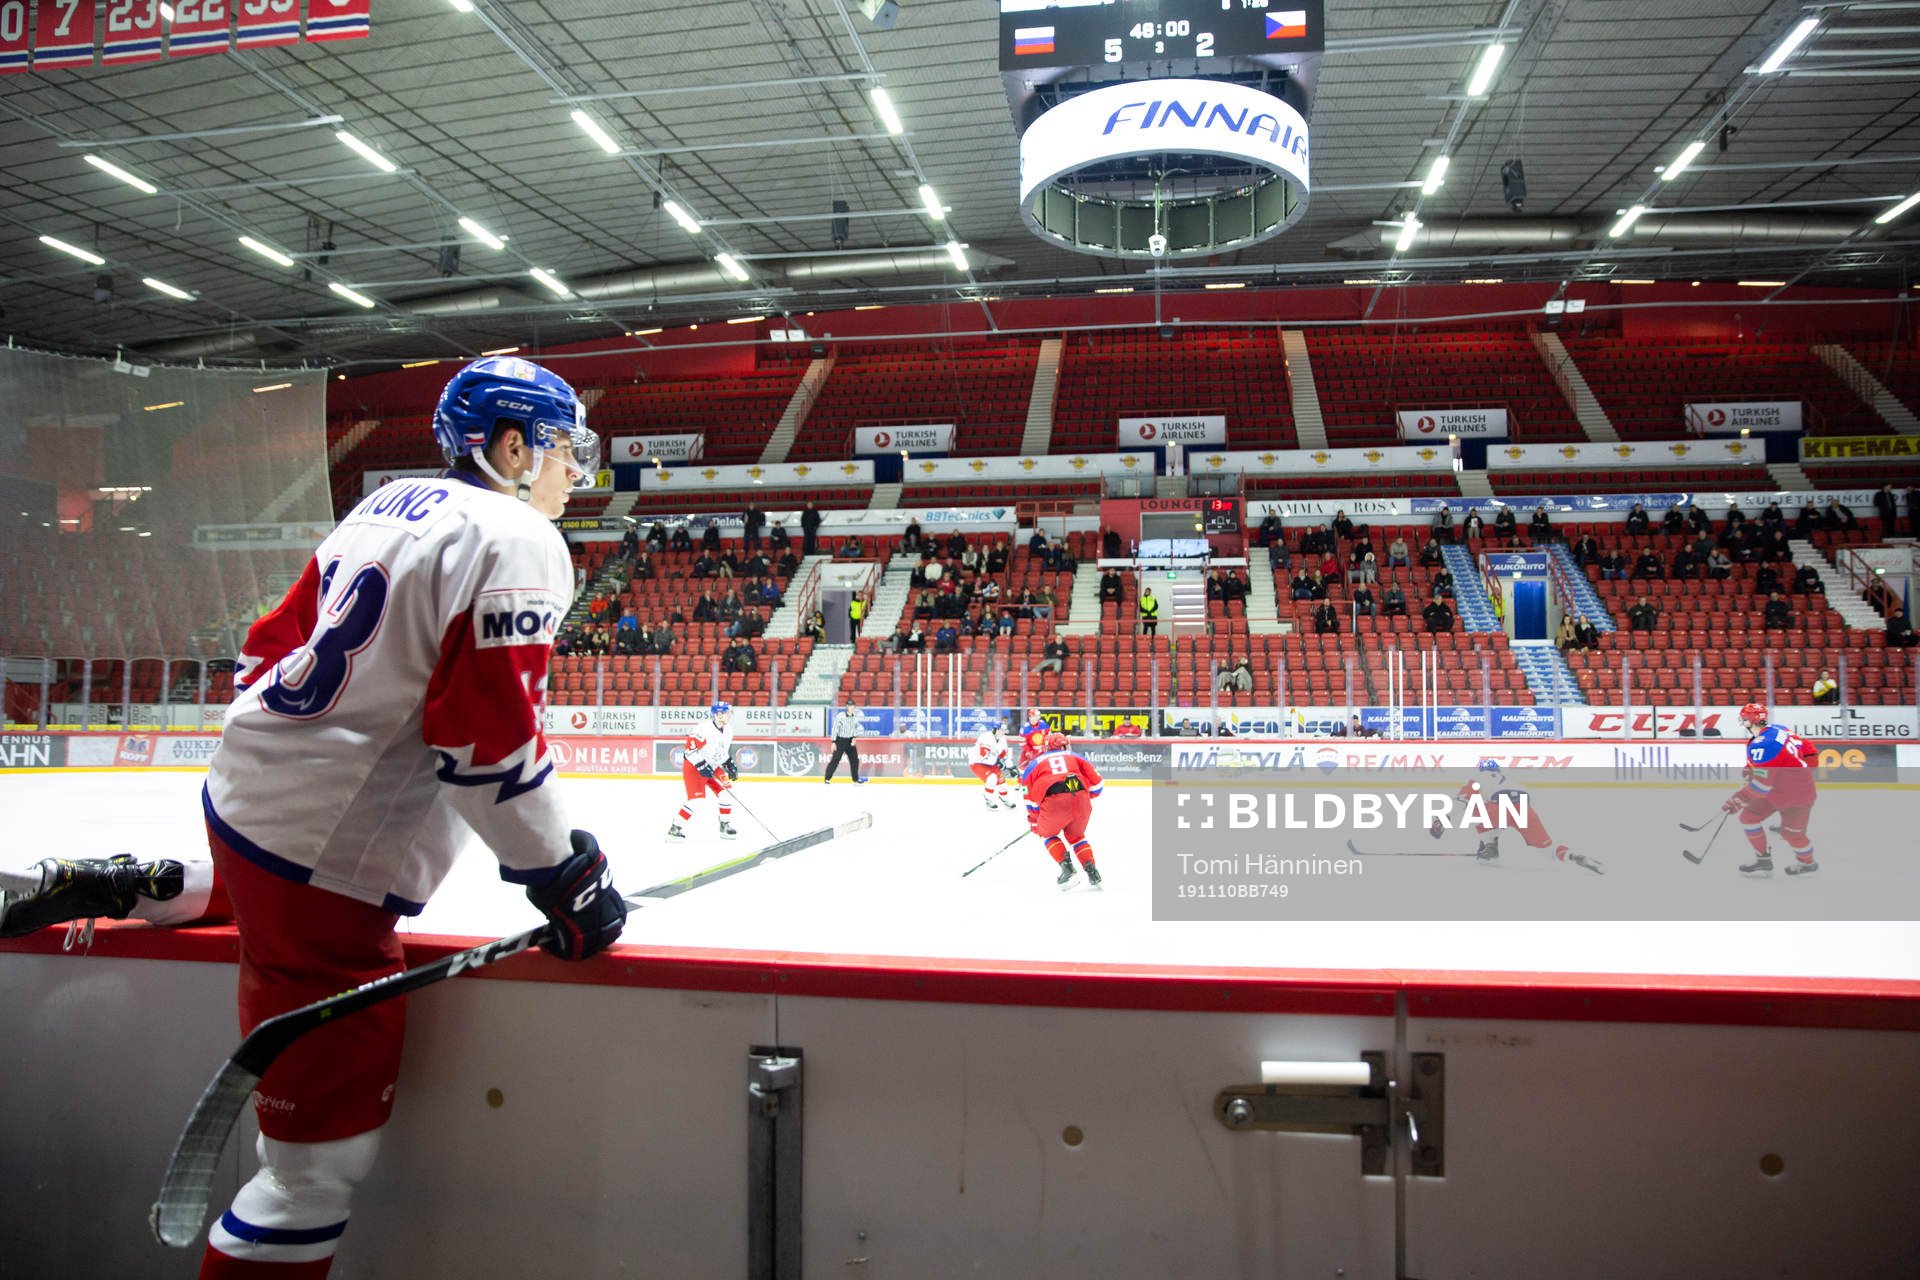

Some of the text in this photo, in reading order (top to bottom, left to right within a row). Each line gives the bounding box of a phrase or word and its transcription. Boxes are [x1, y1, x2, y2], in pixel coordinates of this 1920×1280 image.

[54, 0, 79, 36] 7
[1105, 38, 1122, 62] 5
[1155, 41, 1164, 53] 3
[1196, 32, 1214, 57] 2
[1102, 100, 1308, 161] FINNAIR
[496, 399, 535, 413] CCM
[1731, 407, 1780, 417] TURKISH
[1440, 414, 1486, 424] TURKISH
[1731, 417, 1780, 427] AIRLINES
[1161, 421, 1205, 431] TURKISH
[1440, 423, 1487, 433] AIRLINES
[895, 430, 937, 440] TURKISH
[1160, 430, 1206, 440] AIRLINES
[648, 439, 686, 449] TURKISH
[894, 438, 937, 448] AIRLINES
[1804, 439, 1920, 458] KITEMA
[647, 447, 686, 457] AIRLINES
[1140, 499, 1201, 511] LOUNGE
[1354, 501, 1398, 513] ROSA
[712, 516, 745, 527] Delet
[258, 554, 391, 721] 3
[592, 711, 636, 720] TURKISH
[660, 710, 714, 720] BERENDS
[746, 710, 812, 720] BERENDSEN
[1588, 713, 1722, 732] CCM
[2, 735, 50, 744] ENNUS
[575, 747, 639, 764] NIEMI
[1084, 751, 1162, 763] Mercedes-Benz
[1176, 746, 1306, 773] MÄTYLÄ
[1048, 756, 1068, 775] 9
[1346, 754, 1445, 773] RE/MAX
[1817, 748, 1868, 779] pe
